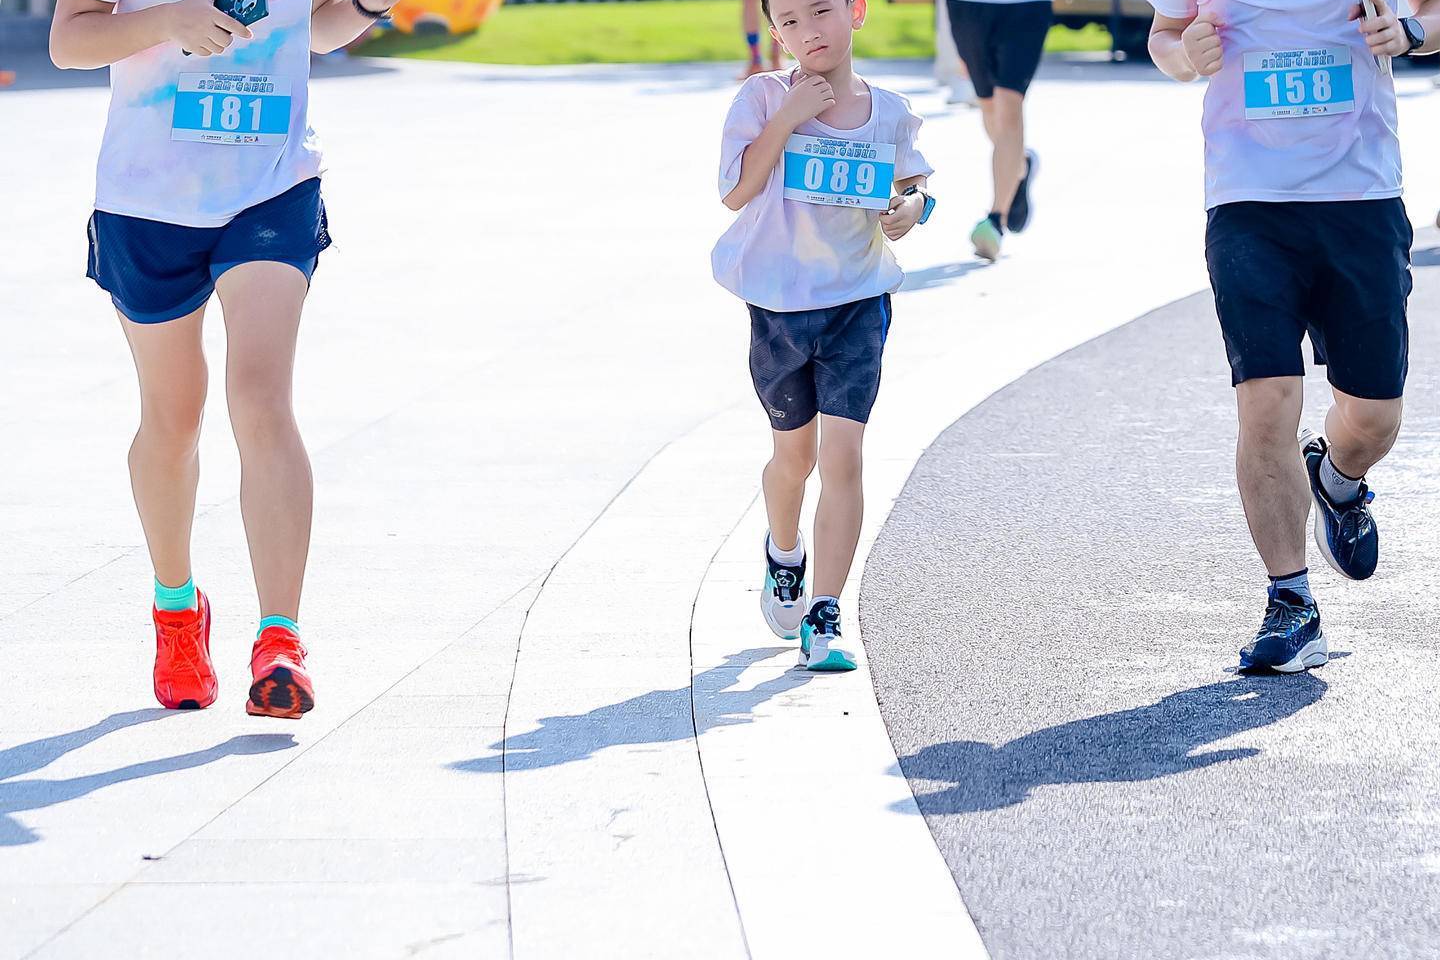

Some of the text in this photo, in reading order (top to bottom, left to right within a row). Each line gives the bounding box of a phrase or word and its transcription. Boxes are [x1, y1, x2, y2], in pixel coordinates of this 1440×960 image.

[1264, 69, 1332, 105] 158
[198, 95, 263, 131] 181
[803, 158, 876, 195] 089
